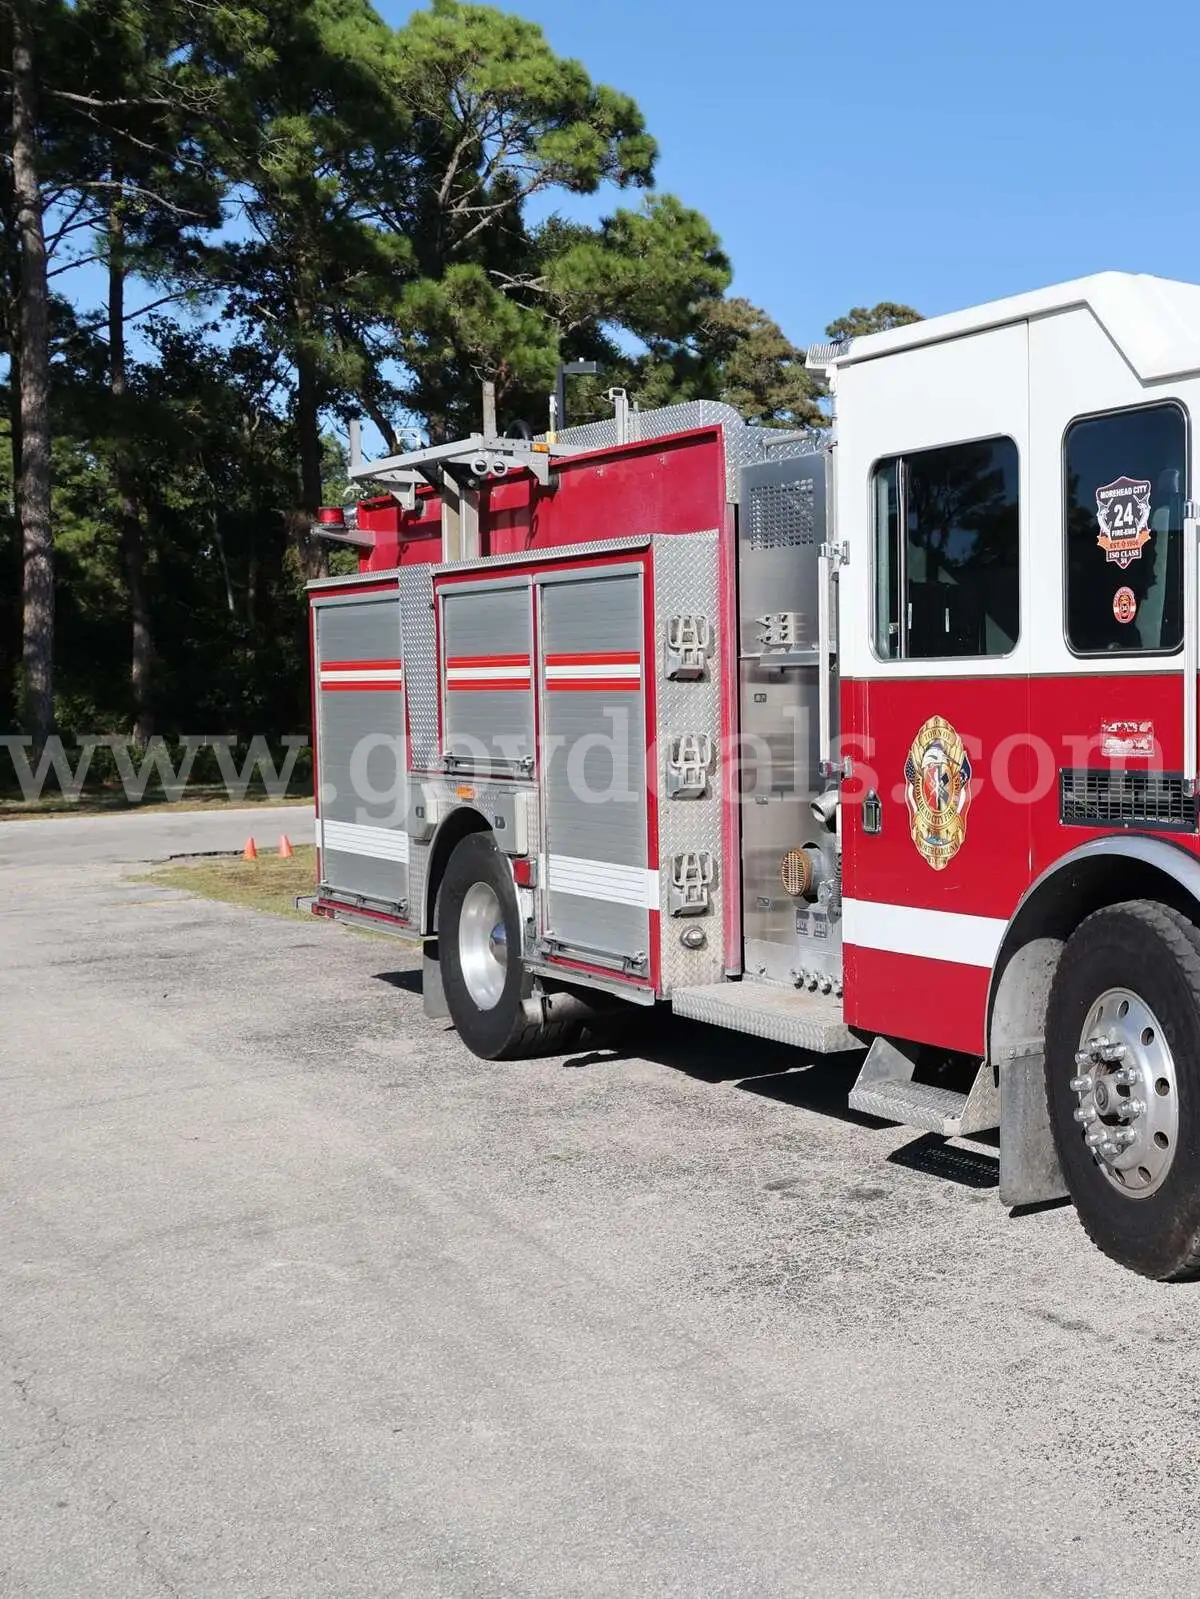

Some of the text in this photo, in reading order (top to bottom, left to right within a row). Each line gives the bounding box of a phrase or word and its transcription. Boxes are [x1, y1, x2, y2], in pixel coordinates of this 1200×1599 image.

[1101, 484, 1148, 499] MOREHEAD CITY
[1113, 502, 1134, 527] 24
[1120, 549, 1139, 558] CLASS
